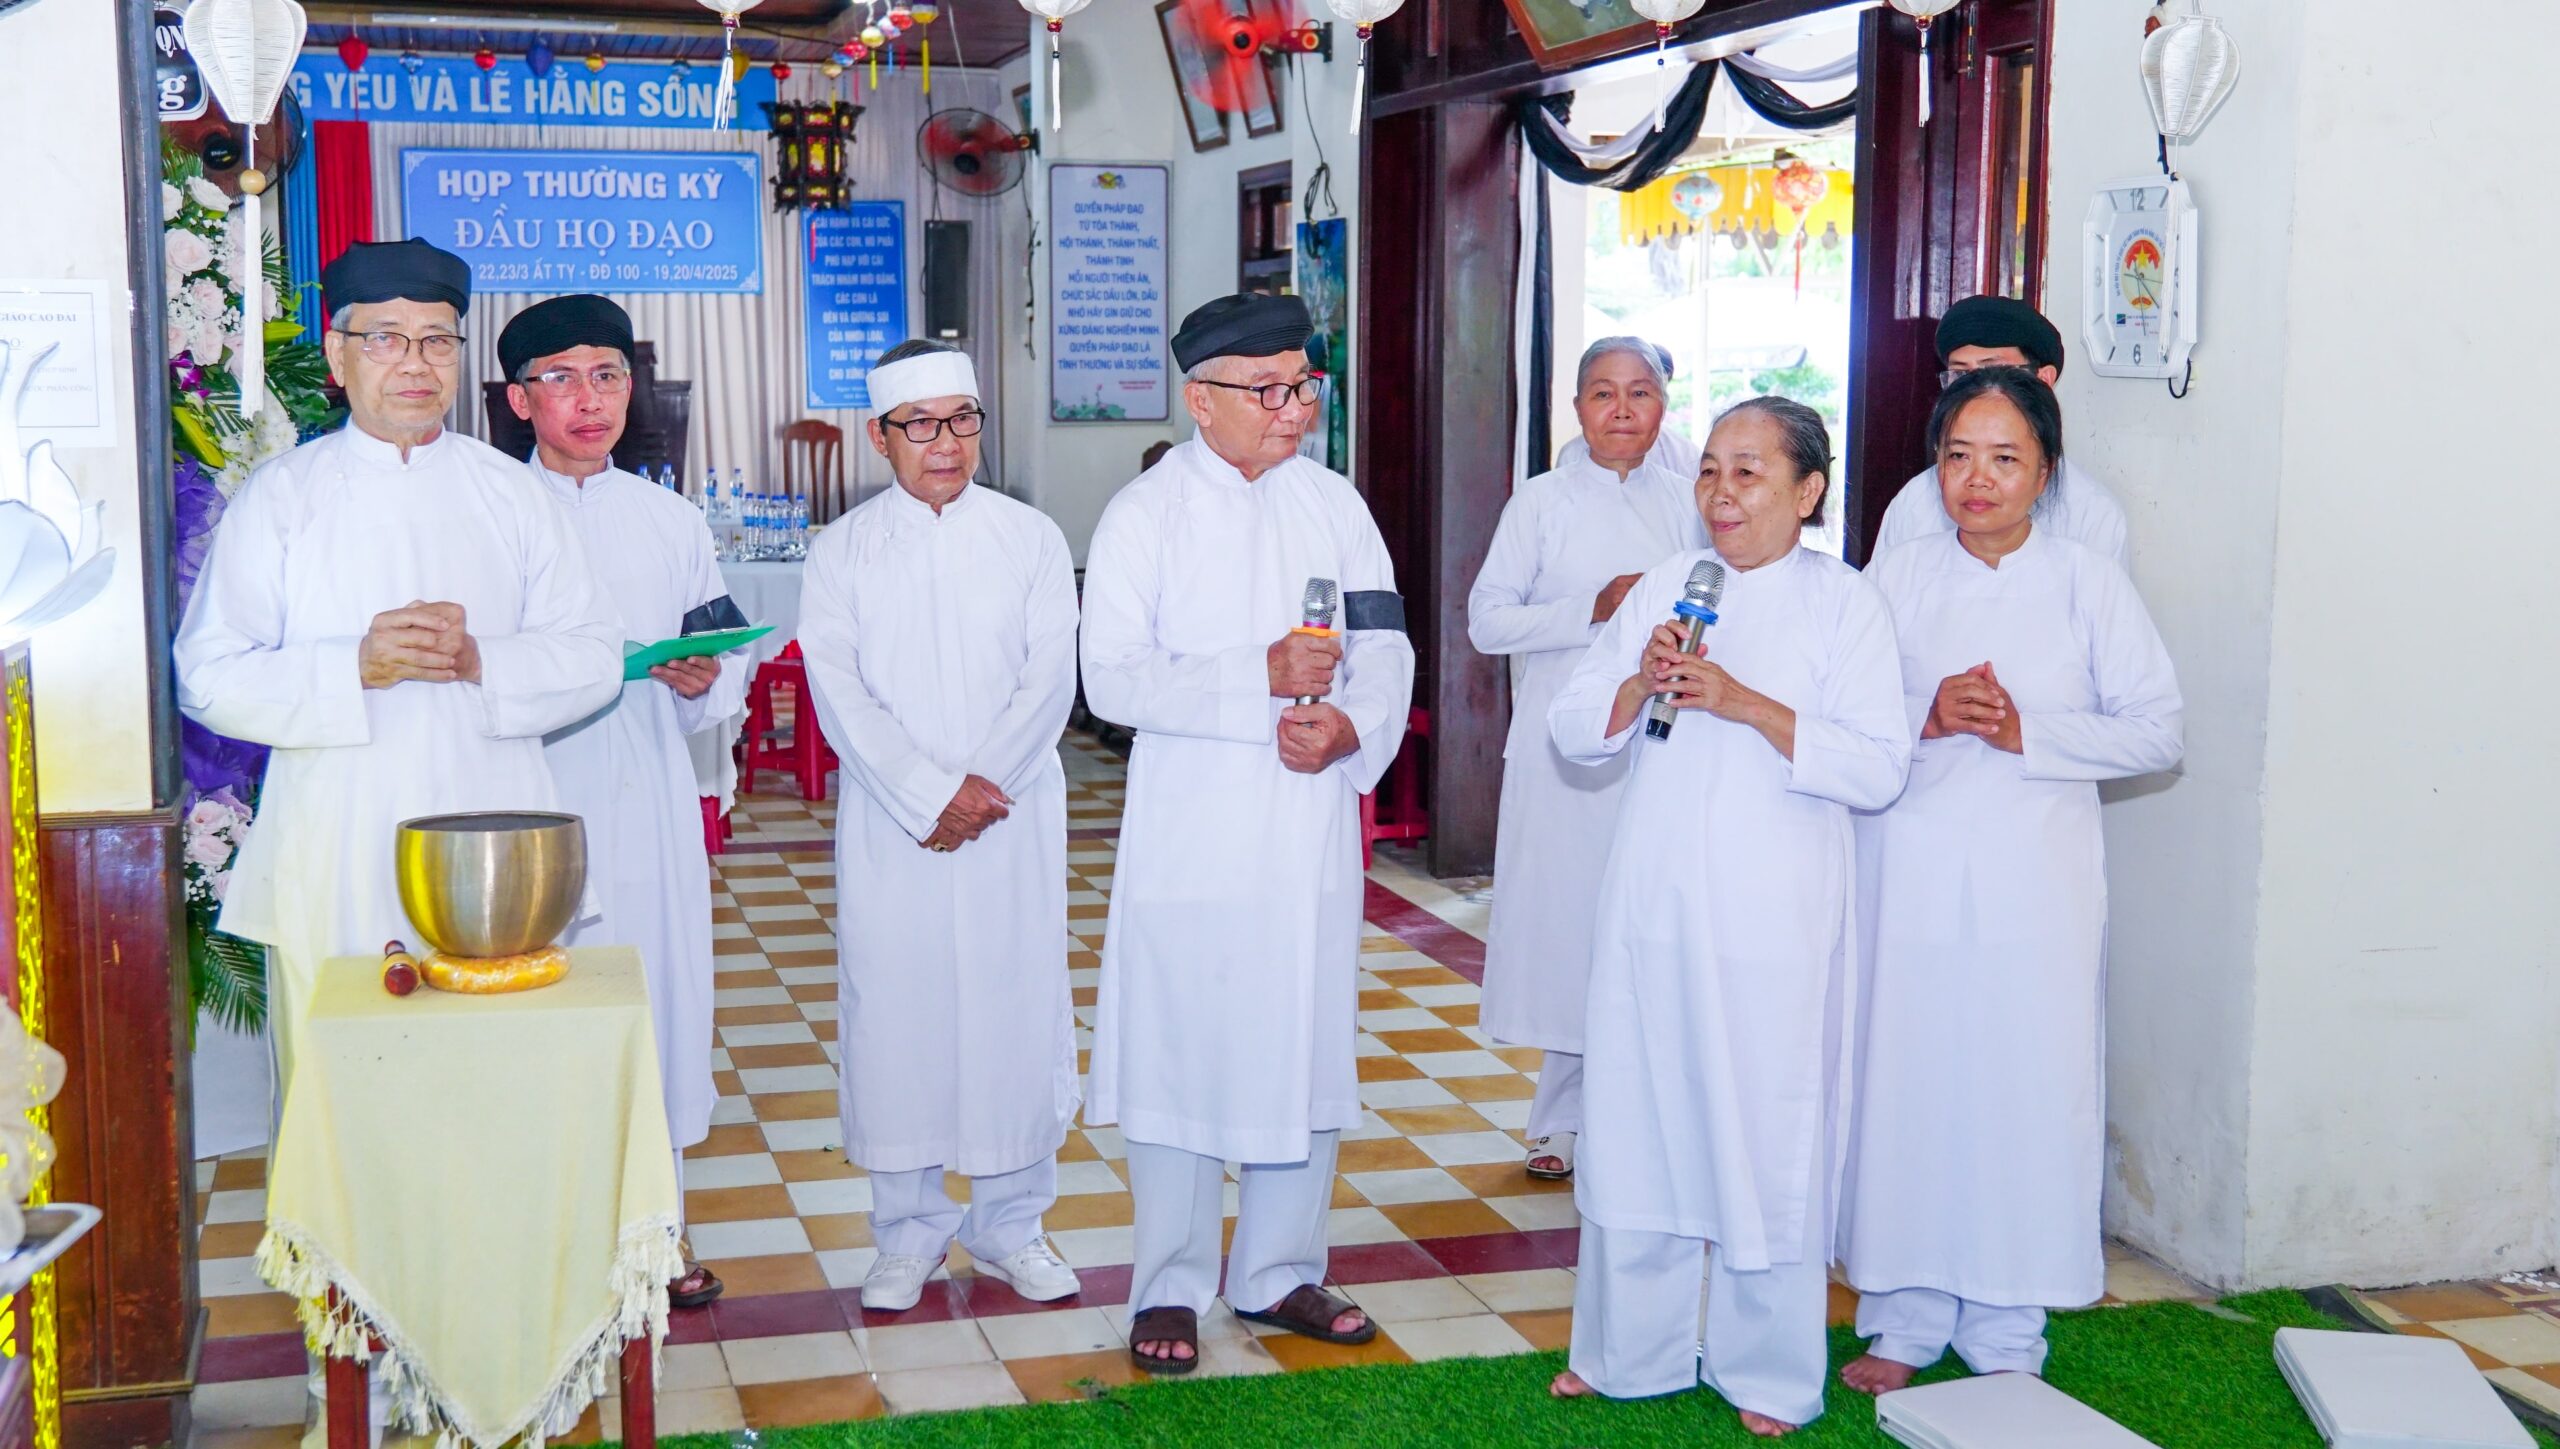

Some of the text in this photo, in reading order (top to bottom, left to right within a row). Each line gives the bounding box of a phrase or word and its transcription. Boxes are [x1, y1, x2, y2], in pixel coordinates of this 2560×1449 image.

[408, 68, 459, 112] VÀ
[470, 70, 512, 114] LẼ
[524, 65, 627, 116] HẰNG
[438, 164, 724, 203] HỌP THƯỜNG KỲ
[2130, 187, 2145, 211] 12
[454, 203, 714, 257] ĐẦU HỌ ĐẠO
[479, 263, 529, 281] 22,23/3
[533, 257, 553, 281] ẤT
[589, 263, 611, 280] ĐĐ
[616, 263, 640, 281] 100
[654, 263, 739, 283] 19,20/4/2025
[29, 312, 54, 322] CAO
[2133, 344, 2141, 365] 6
